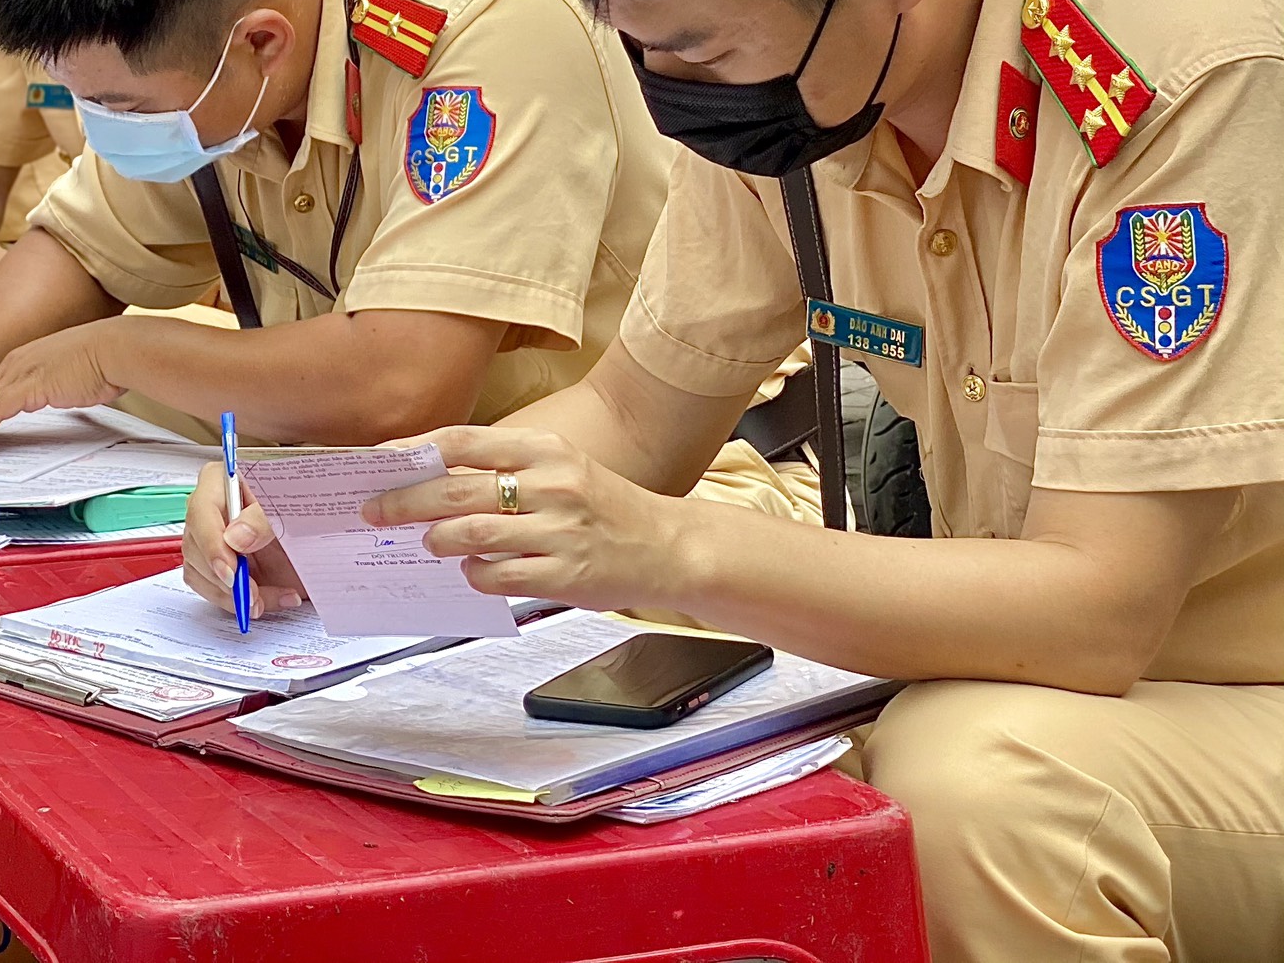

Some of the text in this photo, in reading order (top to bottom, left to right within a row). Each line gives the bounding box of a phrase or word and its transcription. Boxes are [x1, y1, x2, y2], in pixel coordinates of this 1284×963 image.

[411, 147, 478, 164] CSGT
[1117, 283, 1216, 308] CSGT
[870, 323, 887, 339] ANH
[848, 333, 869, 350] 138
[881, 342, 905, 359] 955
